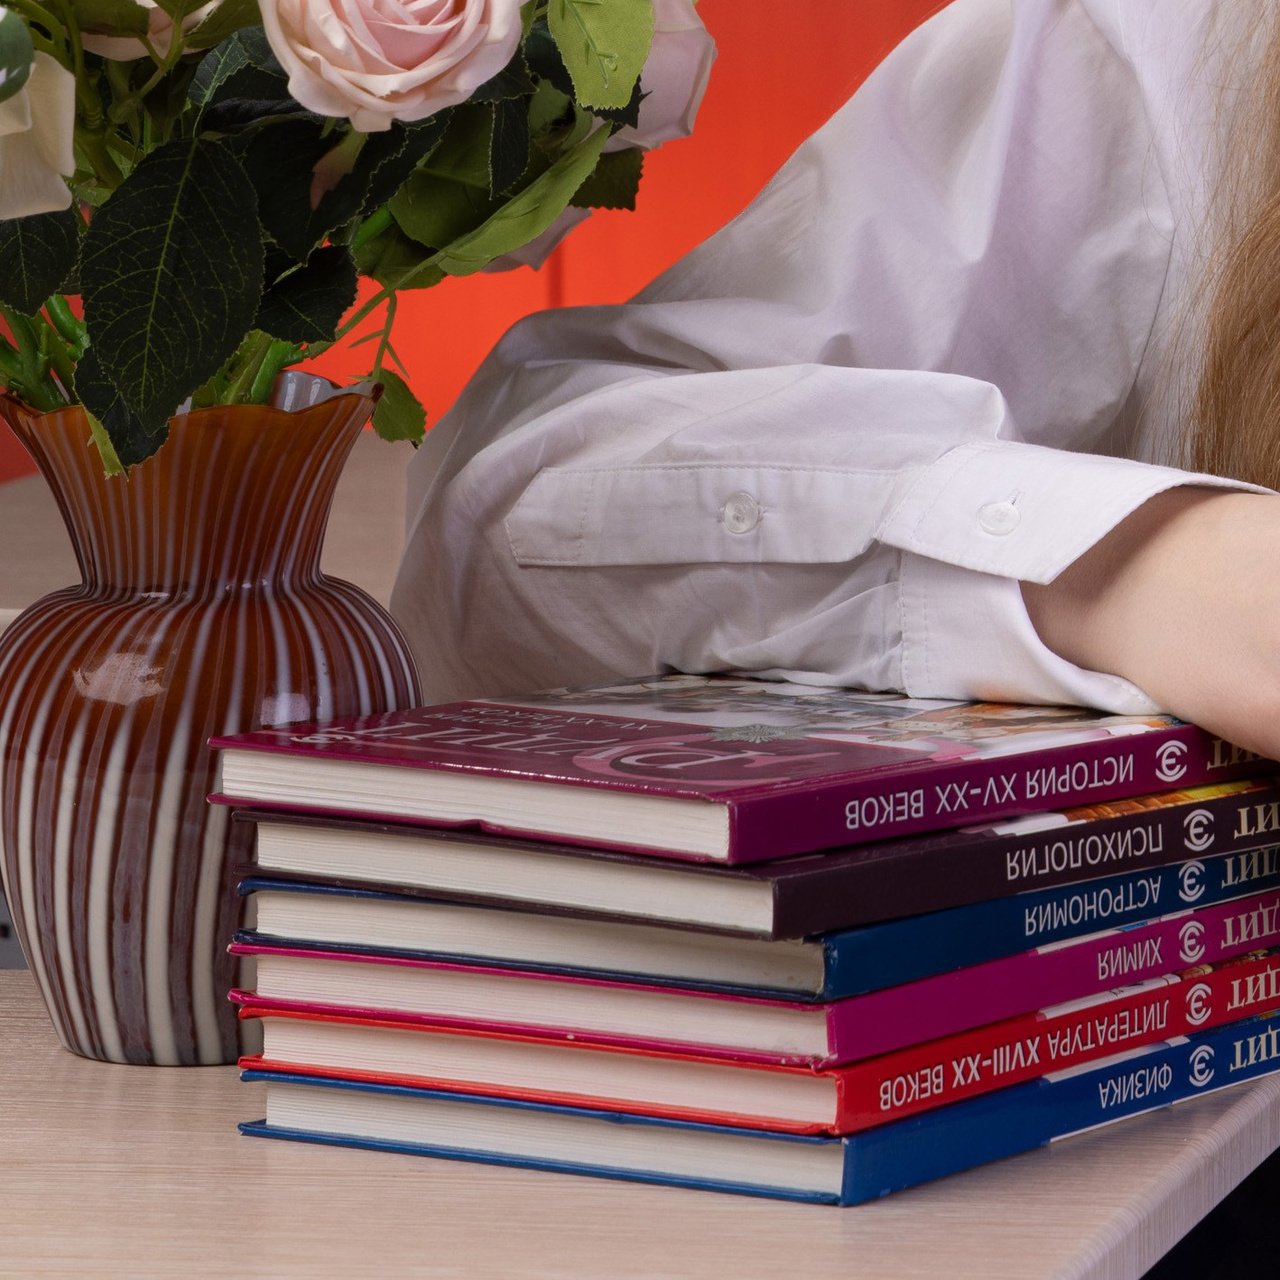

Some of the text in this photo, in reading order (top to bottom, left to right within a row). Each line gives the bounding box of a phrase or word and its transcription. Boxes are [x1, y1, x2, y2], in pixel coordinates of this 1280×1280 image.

[422, 712, 566, 731] ИСТОРИЯ
[461, 706, 557, 722] ВЕКОВ
[1026, 754, 1134, 799] ИСТОРИЯ
[845, 790, 924, 829] ВЕКОВ
[1006, 823, 1163, 880] ПСИХОЛОГИЯ
[1025, 875, 1161, 937] АСТРОНОМИЯ
[1097, 937, 1162, 980] ХИМИЯ
[1048, 1000, 1169, 1059] ЛИТЕРАТУРА
[879, 1065, 944, 1110] ВЕКОВ
[1099, 1063, 1172, 1109] ФИЗИКА
